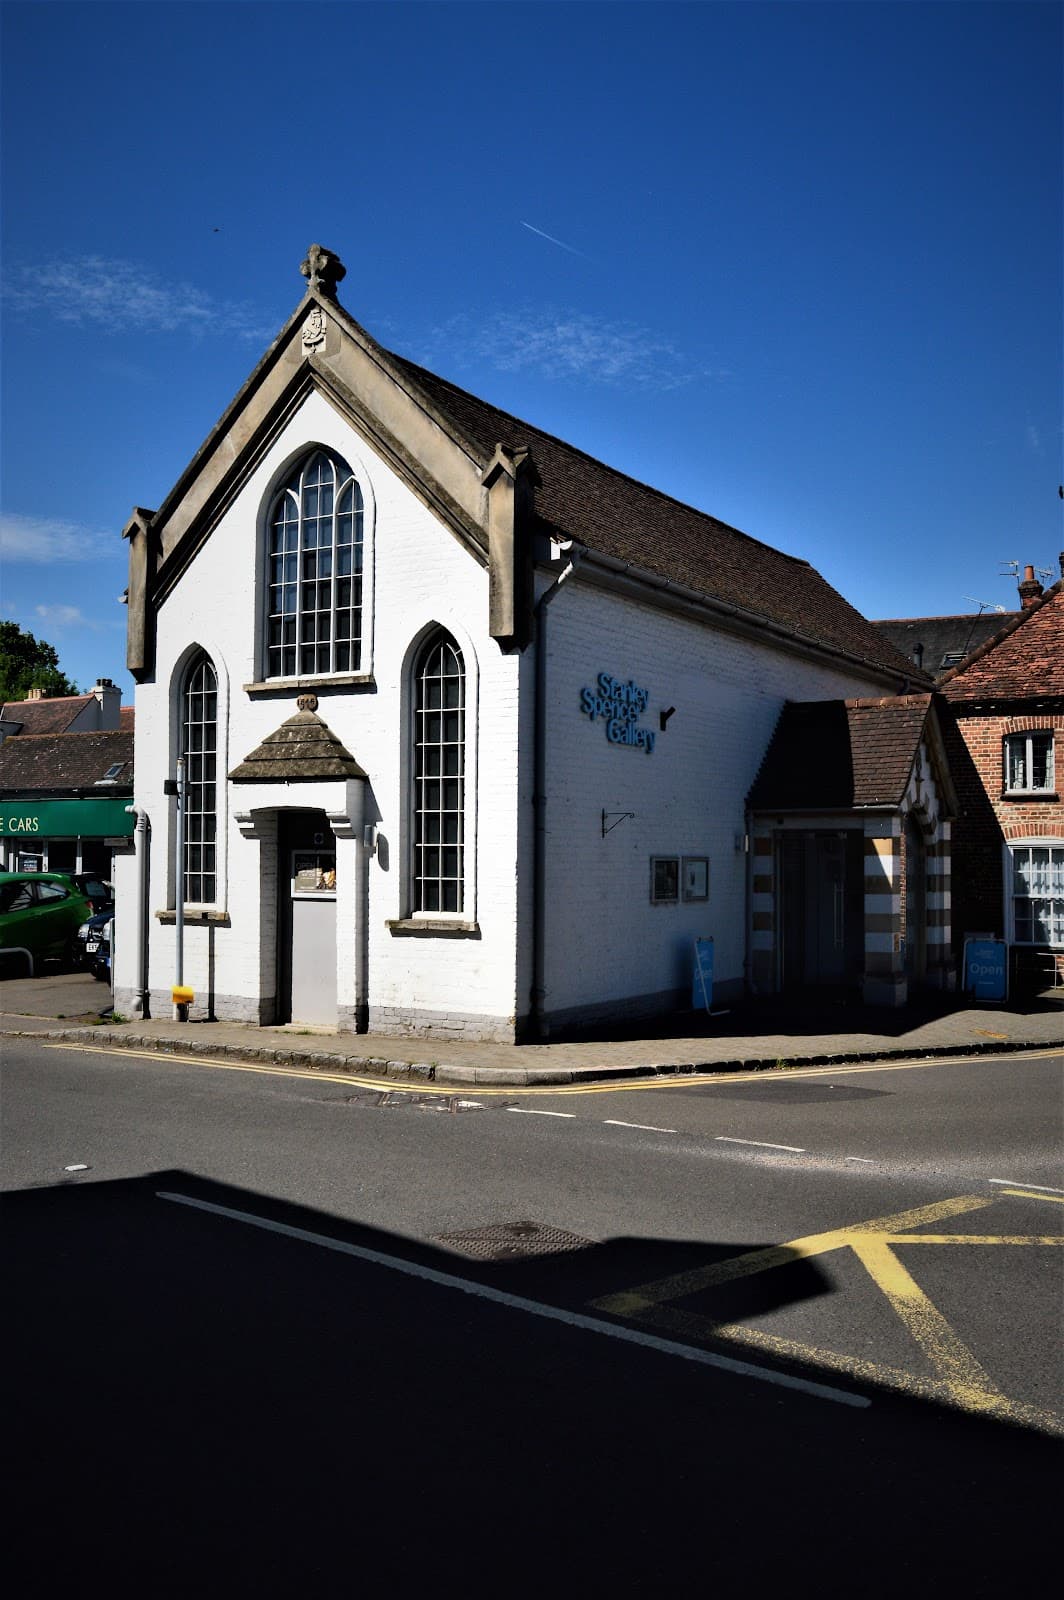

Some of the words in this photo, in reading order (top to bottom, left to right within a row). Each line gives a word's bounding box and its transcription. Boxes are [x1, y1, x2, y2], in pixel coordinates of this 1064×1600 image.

[580, 687, 641, 722] Spencer
[598, 672, 650, 712] Stanley
[606, 719, 655, 754] Gallery
[9, 817, 39, 832] CARS
[969, 962, 1003, 976] Open
